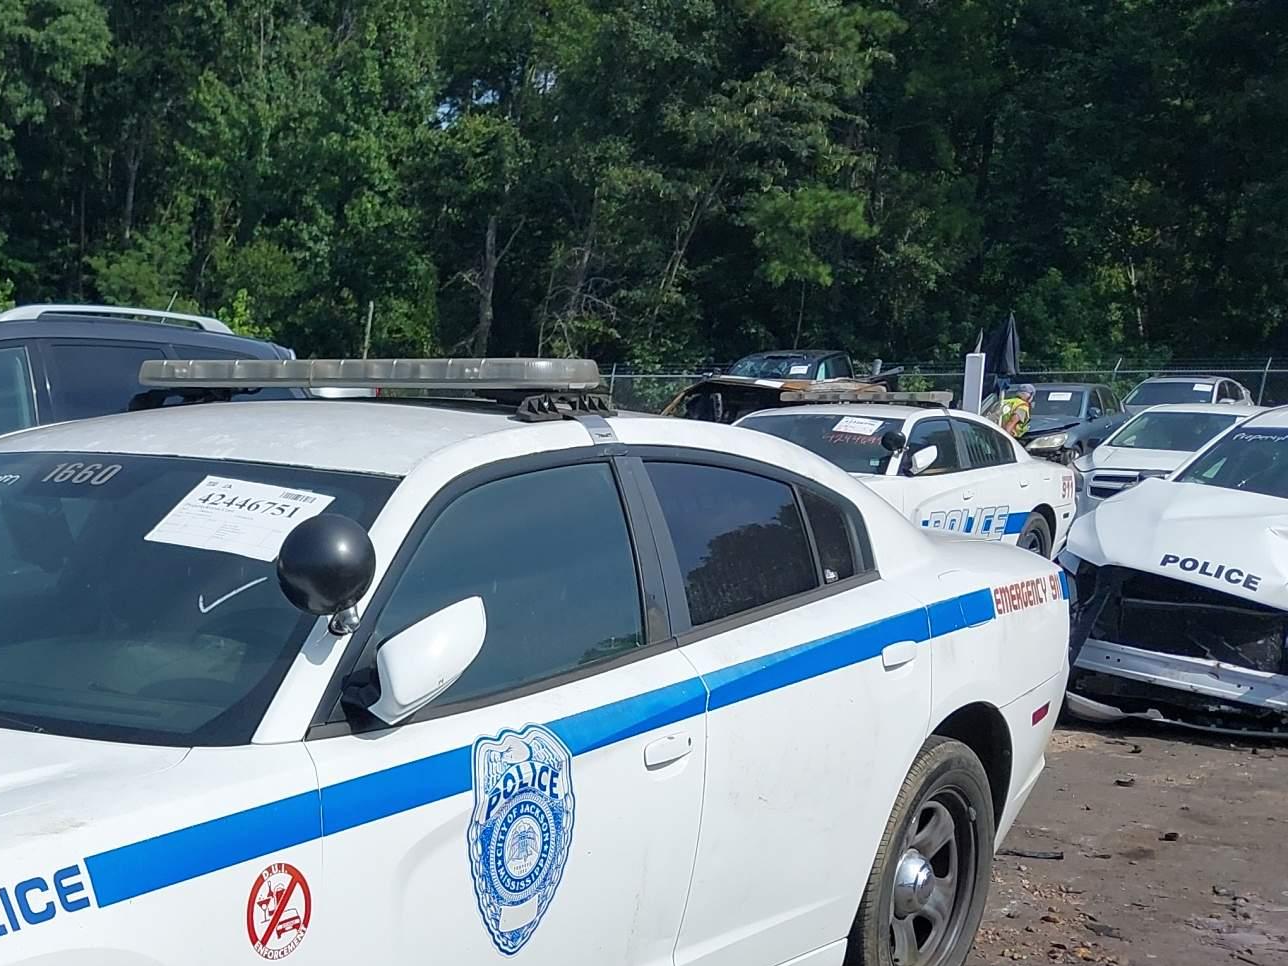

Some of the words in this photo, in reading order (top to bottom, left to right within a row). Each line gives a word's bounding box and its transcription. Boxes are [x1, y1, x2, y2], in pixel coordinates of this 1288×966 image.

[41, 462, 122, 486] 1660
[198, 492, 300, 519] 42446751
[1160, 553, 1261, 591] POLICE
[993, 577, 1048, 615] EMERGENCY
[485, 760, 560, 820] POLICE
[496, 822, 509, 857] CITY
[507, 806, 518, 824] OF
[519, 802, 550, 842] JACKSON
[496, 851, 548, 892] MISSISSIPPI
[254, 925, 308, 960] ENFORCEMENT
